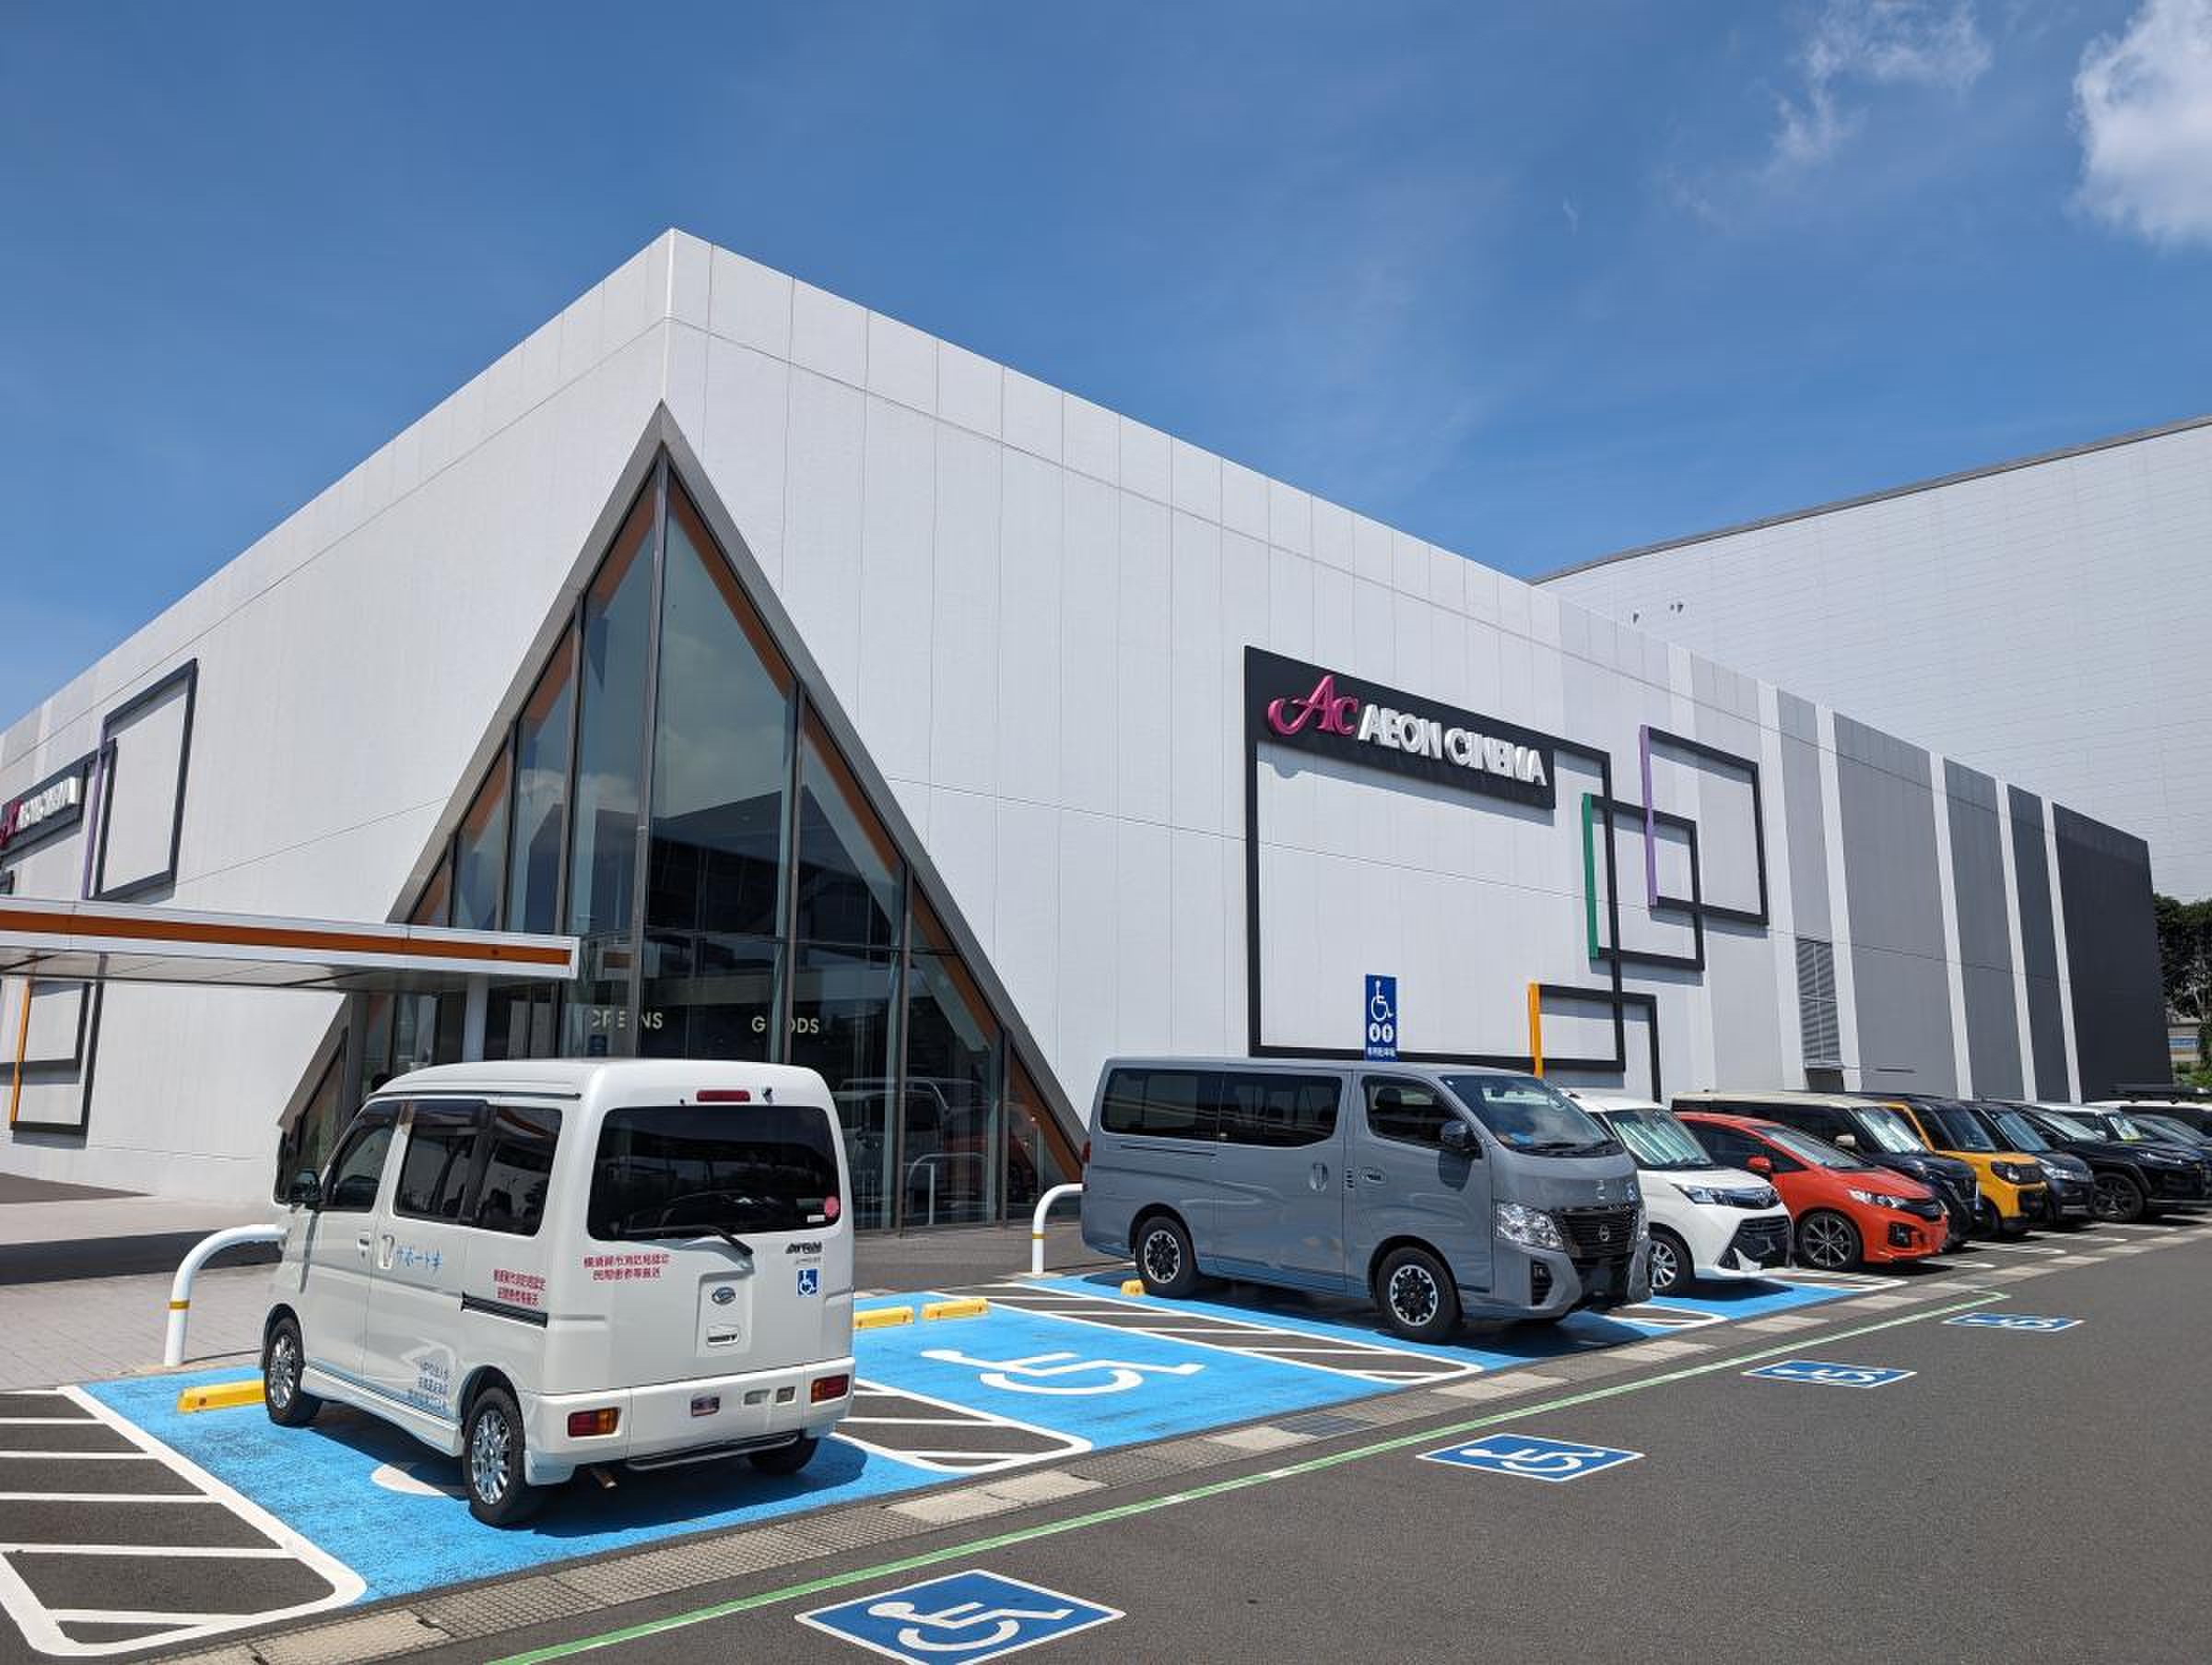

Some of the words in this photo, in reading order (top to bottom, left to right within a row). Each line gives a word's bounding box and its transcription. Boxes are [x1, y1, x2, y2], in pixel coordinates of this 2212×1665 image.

[1358, 703, 1442, 760] AEON
[1444, 727, 1547, 786] CINEMA
[751, 1016, 820, 1033] GDS
